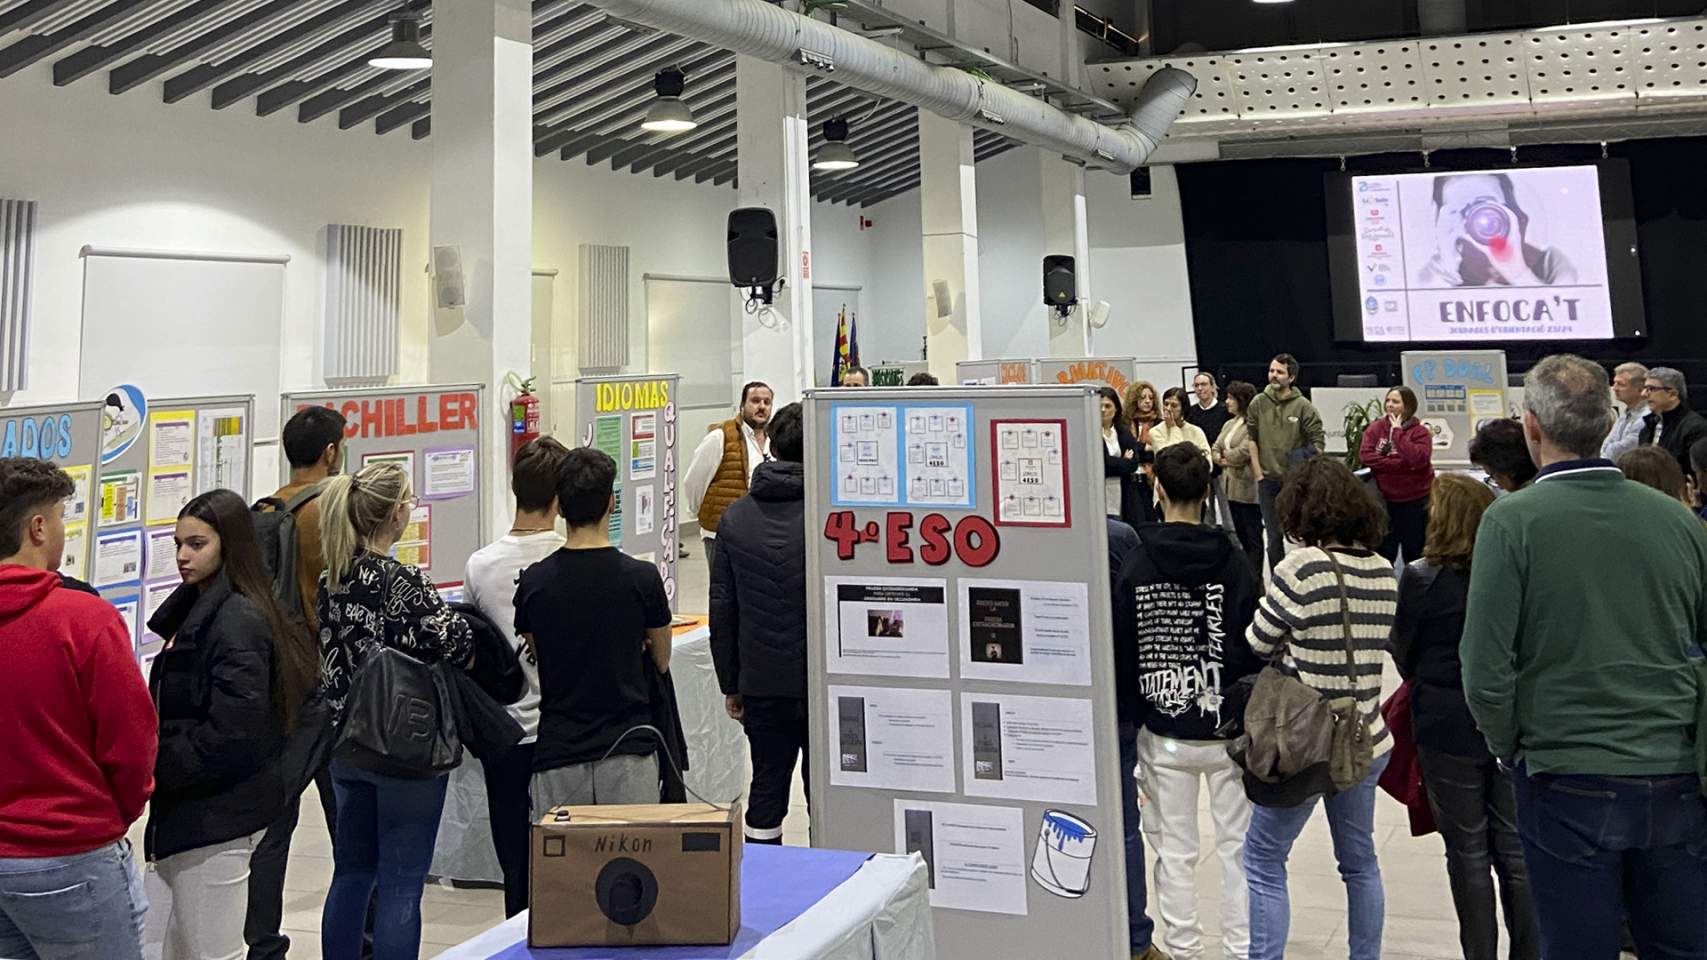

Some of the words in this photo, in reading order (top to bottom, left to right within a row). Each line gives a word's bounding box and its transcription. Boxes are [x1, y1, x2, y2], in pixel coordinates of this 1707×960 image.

[1439, 296, 1580, 323] ENFOCA'T
[296, 392, 478, 438] CHILLER
[595, 380, 668, 412] IDIOMAS
[886, 511, 1000, 568] ESO
[1205, 583, 1227, 660] FEARLESS
[594, 833, 653, 853] Nikon
